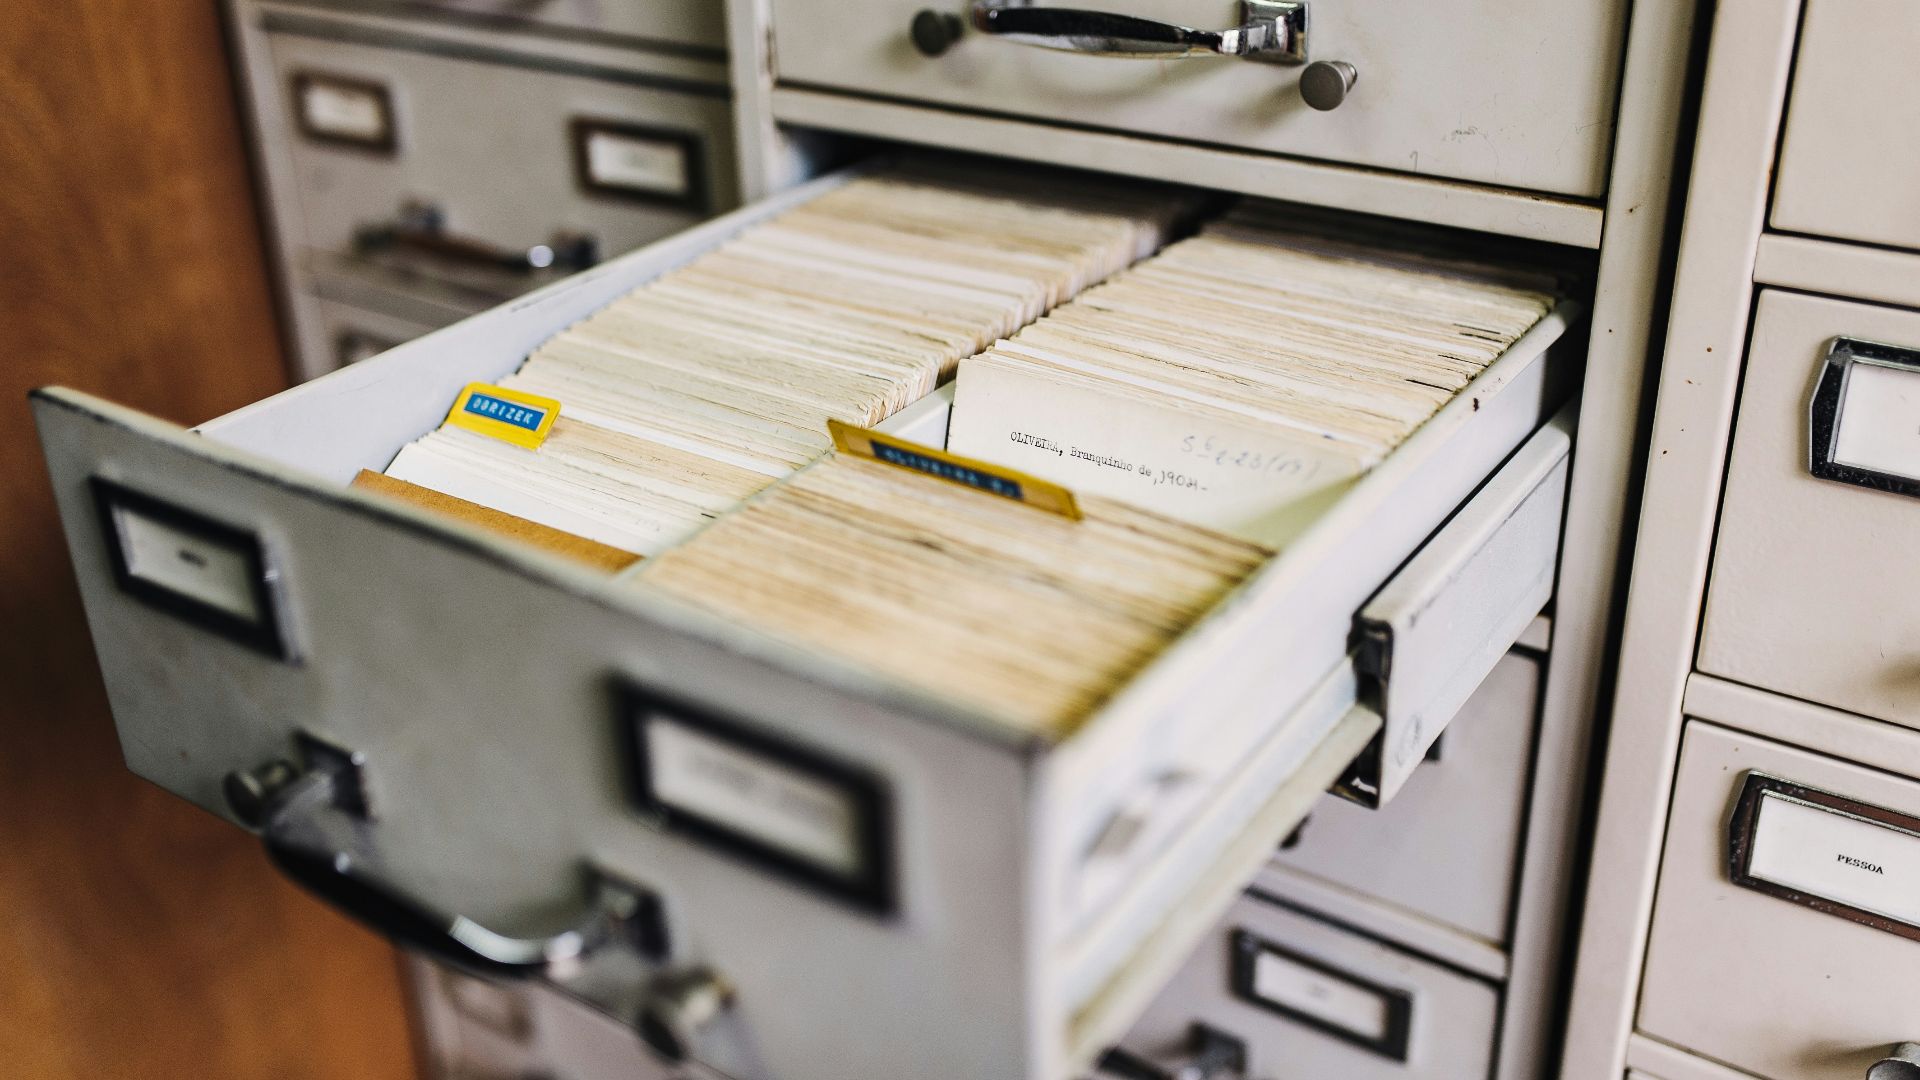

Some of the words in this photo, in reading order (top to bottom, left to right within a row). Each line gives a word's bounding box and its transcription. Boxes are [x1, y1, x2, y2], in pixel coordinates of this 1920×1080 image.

[1010, 431, 1063, 457] OLIVEIRA,
[1070, 446, 1133, 471] Branquinho
[1837, 853, 1884, 875] PESSOA
